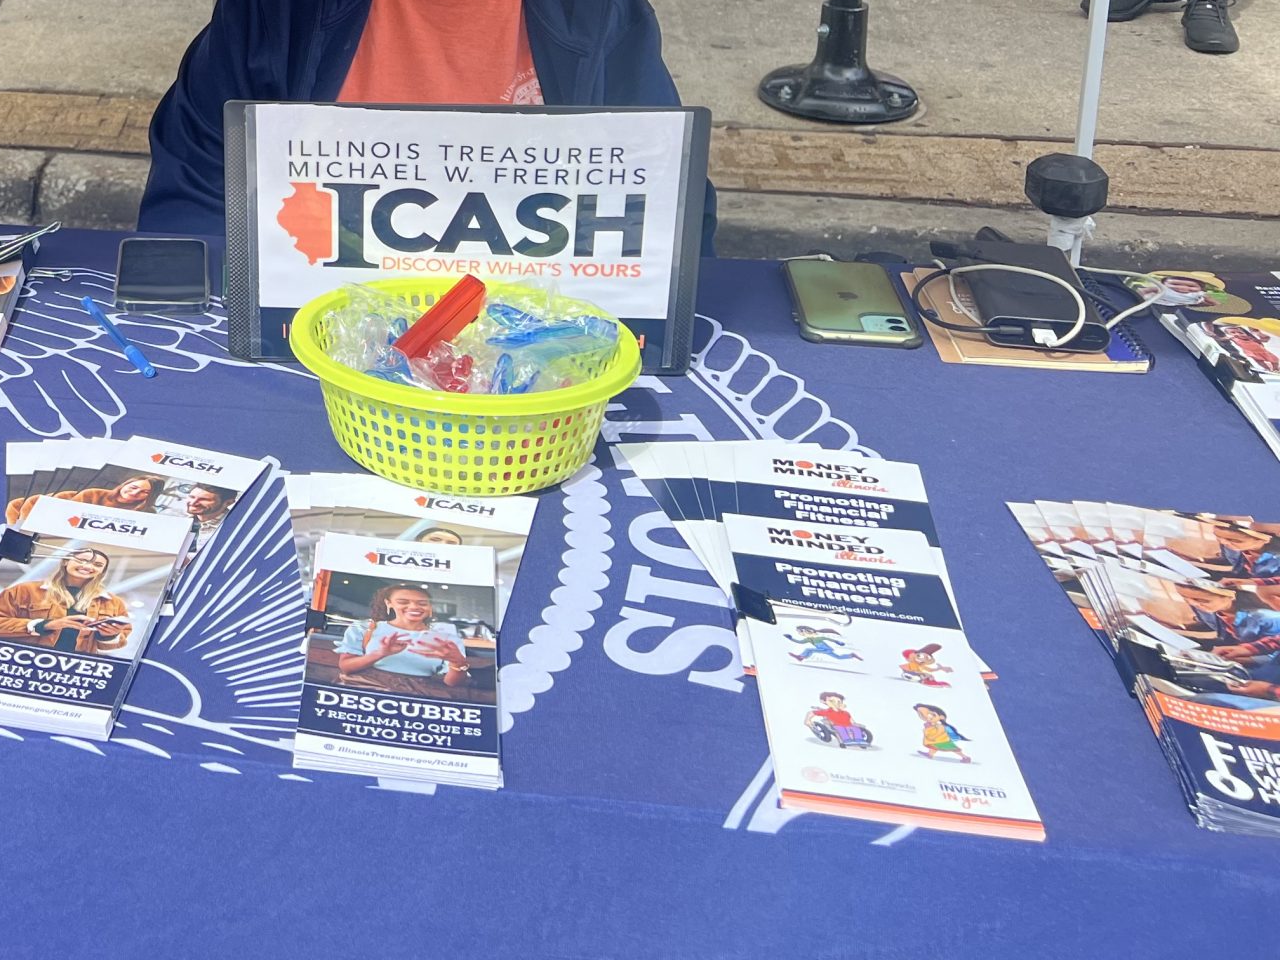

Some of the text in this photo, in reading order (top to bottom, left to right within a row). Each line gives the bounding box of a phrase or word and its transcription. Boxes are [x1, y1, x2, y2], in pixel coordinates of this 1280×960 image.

[287, 139, 625, 165] ILLINOIS TREASURER
[288, 160, 646, 185] MICHAEL W. FRERICHS
[322, 182, 648, 269] ICASH
[381, 255, 642, 279] DISCOVER WHAT'S YOURS
[159, 453, 225, 475] ICASH
[771, 465, 880, 485] MINDED
[831, 480, 889, 494] illinois
[425, 495, 497, 517] ICASH
[774, 489, 895, 515] Promoting
[783, 499, 889, 522] Financial
[78, 516, 148, 536] ICASH
[795, 510, 880, 529] Fitness
[768, 534, 885, 557] MINDED
[376, 551, 451, 570] ICASH
[834, 549, 896, 566] illinois
[775, 561, 906, 590] Promoting
[787, 574, 902, 599] Financial
[801, 585, 893, 608] Fitness
[26, 680, 92, 701] TODAY
[36, 668, 108, 690] WHAT'S
[315, 688, 482, 724] DESCUBRE
[314, 707, 482, 737] Y RECLAMA LO QUE ES
[342, 722, 452, 747] TUYO HOY!
[939, 783, 1007, 799] INVESTED
[942, 793, 958, 801] IN
